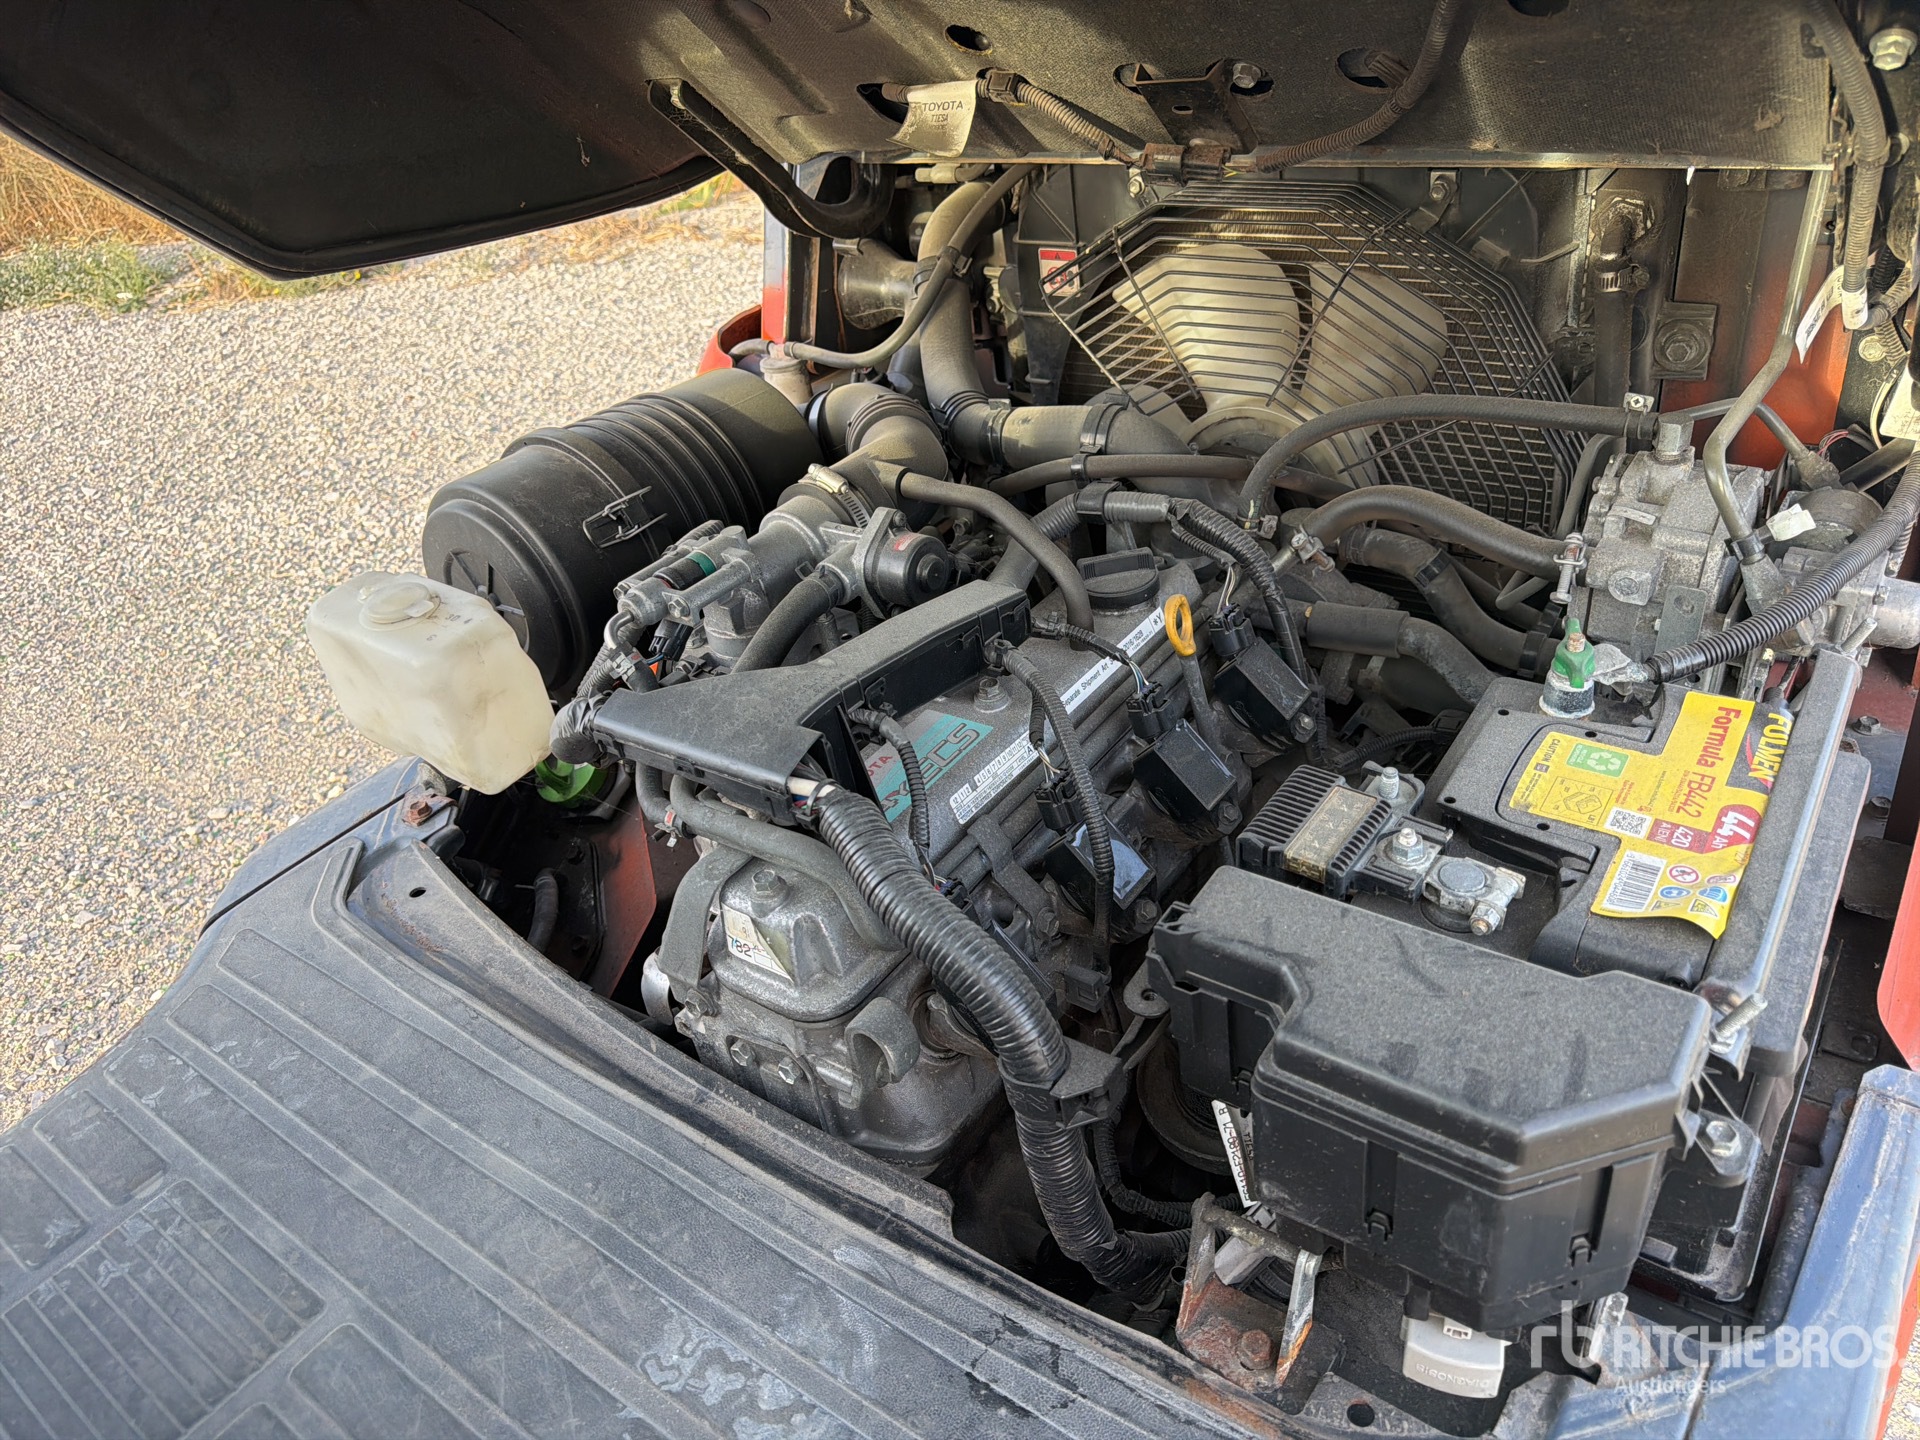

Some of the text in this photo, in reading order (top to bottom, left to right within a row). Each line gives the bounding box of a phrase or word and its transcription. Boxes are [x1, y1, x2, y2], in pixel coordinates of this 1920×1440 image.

[922, 101, 964, 112] TOYOTA
[1081, 670, 1102, 691] Shipment
[1101, 662, 1110, 673] Art
[1541, 738, 1561, 763] CAUTION
[1696, 706, 1742, 768] Formula
[1747, 712, 1794, 783] FULMEN
[1675, 771, 1717, 819] FB442
[1669, 826, 1695, 849] 420
[1710, 810, 1756, 849] 44 Ah
[1415, 1363, 1490, 1388] DIAGNOSIS
